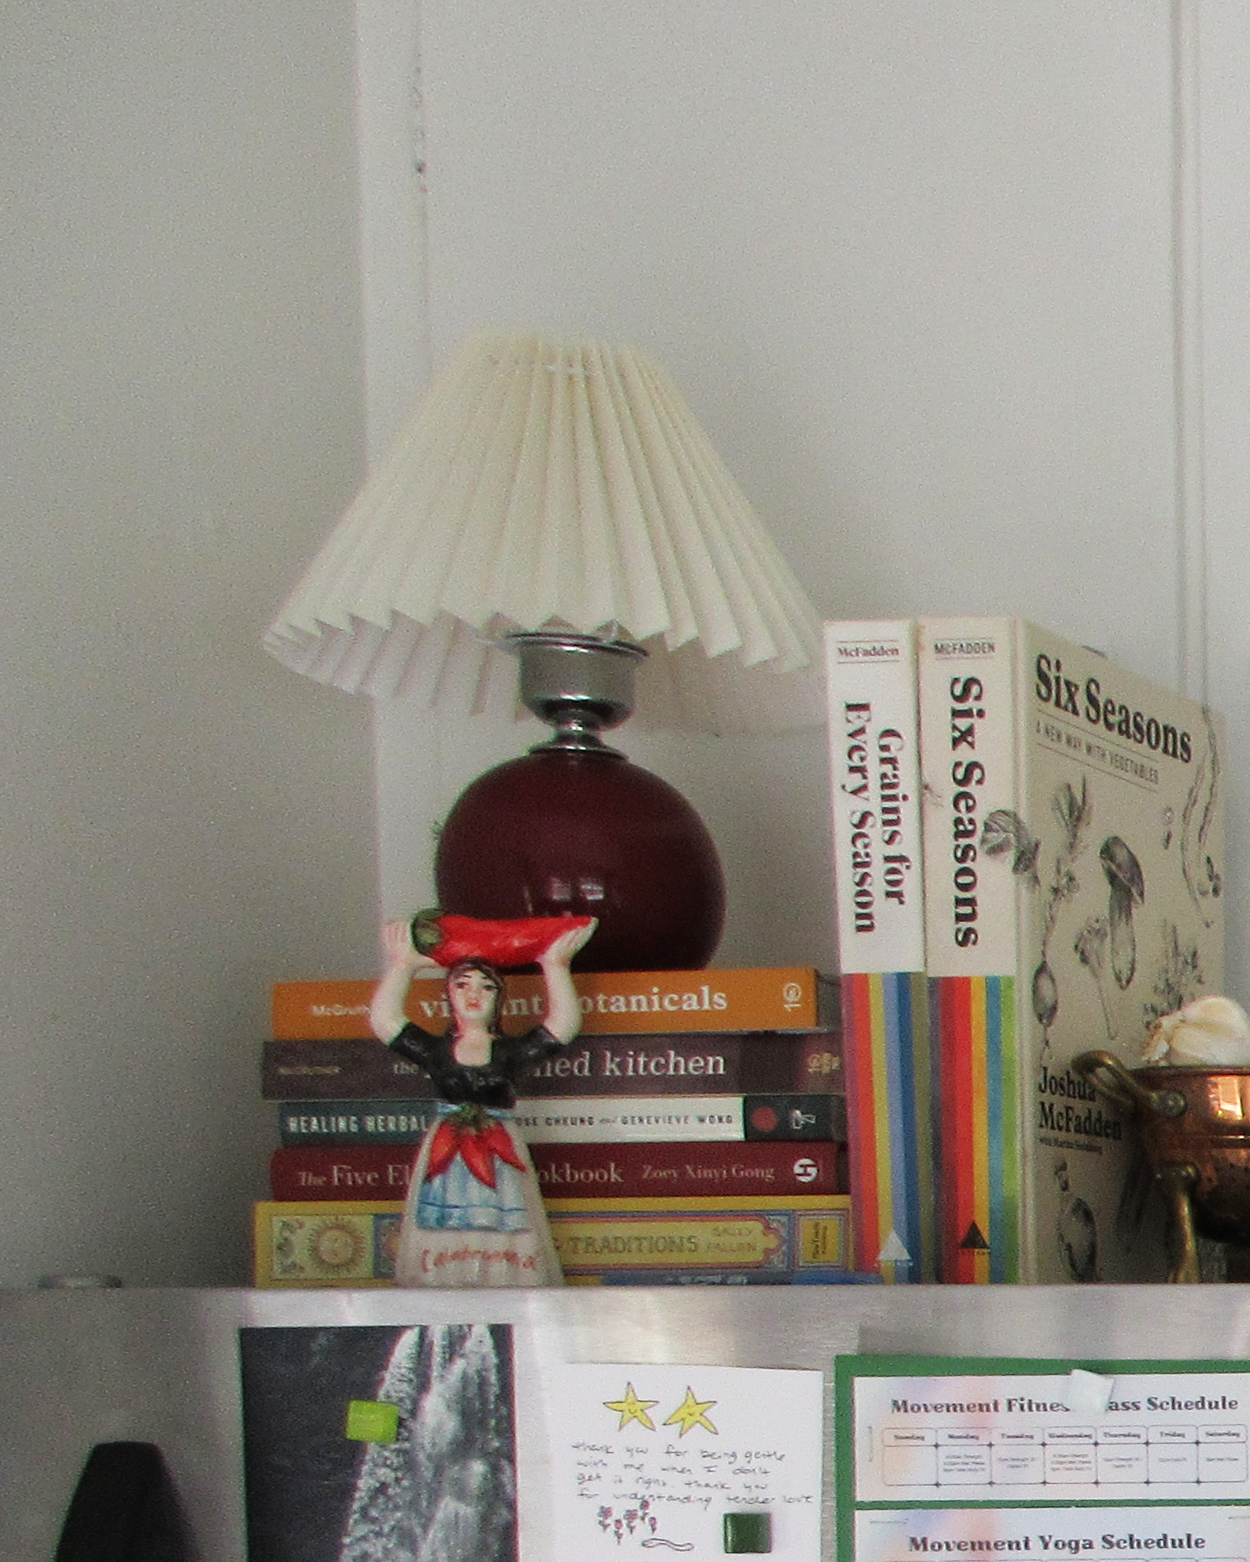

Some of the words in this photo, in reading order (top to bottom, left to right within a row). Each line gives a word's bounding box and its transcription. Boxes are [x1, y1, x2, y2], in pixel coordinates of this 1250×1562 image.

[950, 675, 985, 751] Six
[1036, 654, 1080, 716] Six
[1085, 677, 1192, 764] Seasons
[841, 701, 871, 800] Every
[879, 728, 909, 846] Grains
[851, 810, 875, 934] Season
[951, 760, 985, 948] Seasons
[883, 852, 911, 905] for
[578, 986, 728, 1014] otanicals
[602, 1050, 726, 1077] kitchen
[288, 1115, 358, 1133] HEALING
[366, 1115, 429, 1133] HERBAL
[515, 1116, 538, 1127] OSE
[1038, 1101, 1122, 1140] McFadden
[332, 1164, 379, 1186] Five
[539, 1162, 624, 1183] okbook
[891, 1398, 1000, 1413] Movement
[1006, 1397, 1072, 1413] Fitnes
[1108, 1400, 1141, 1412] ass
[1147, 1396, 1239, 1412] Schedule
[909, 1536, 1031, 1551] Movement
[1038, 1535, 1095, 1554] Yoga
[1101, 1533, 1206, 1549] Schedule
